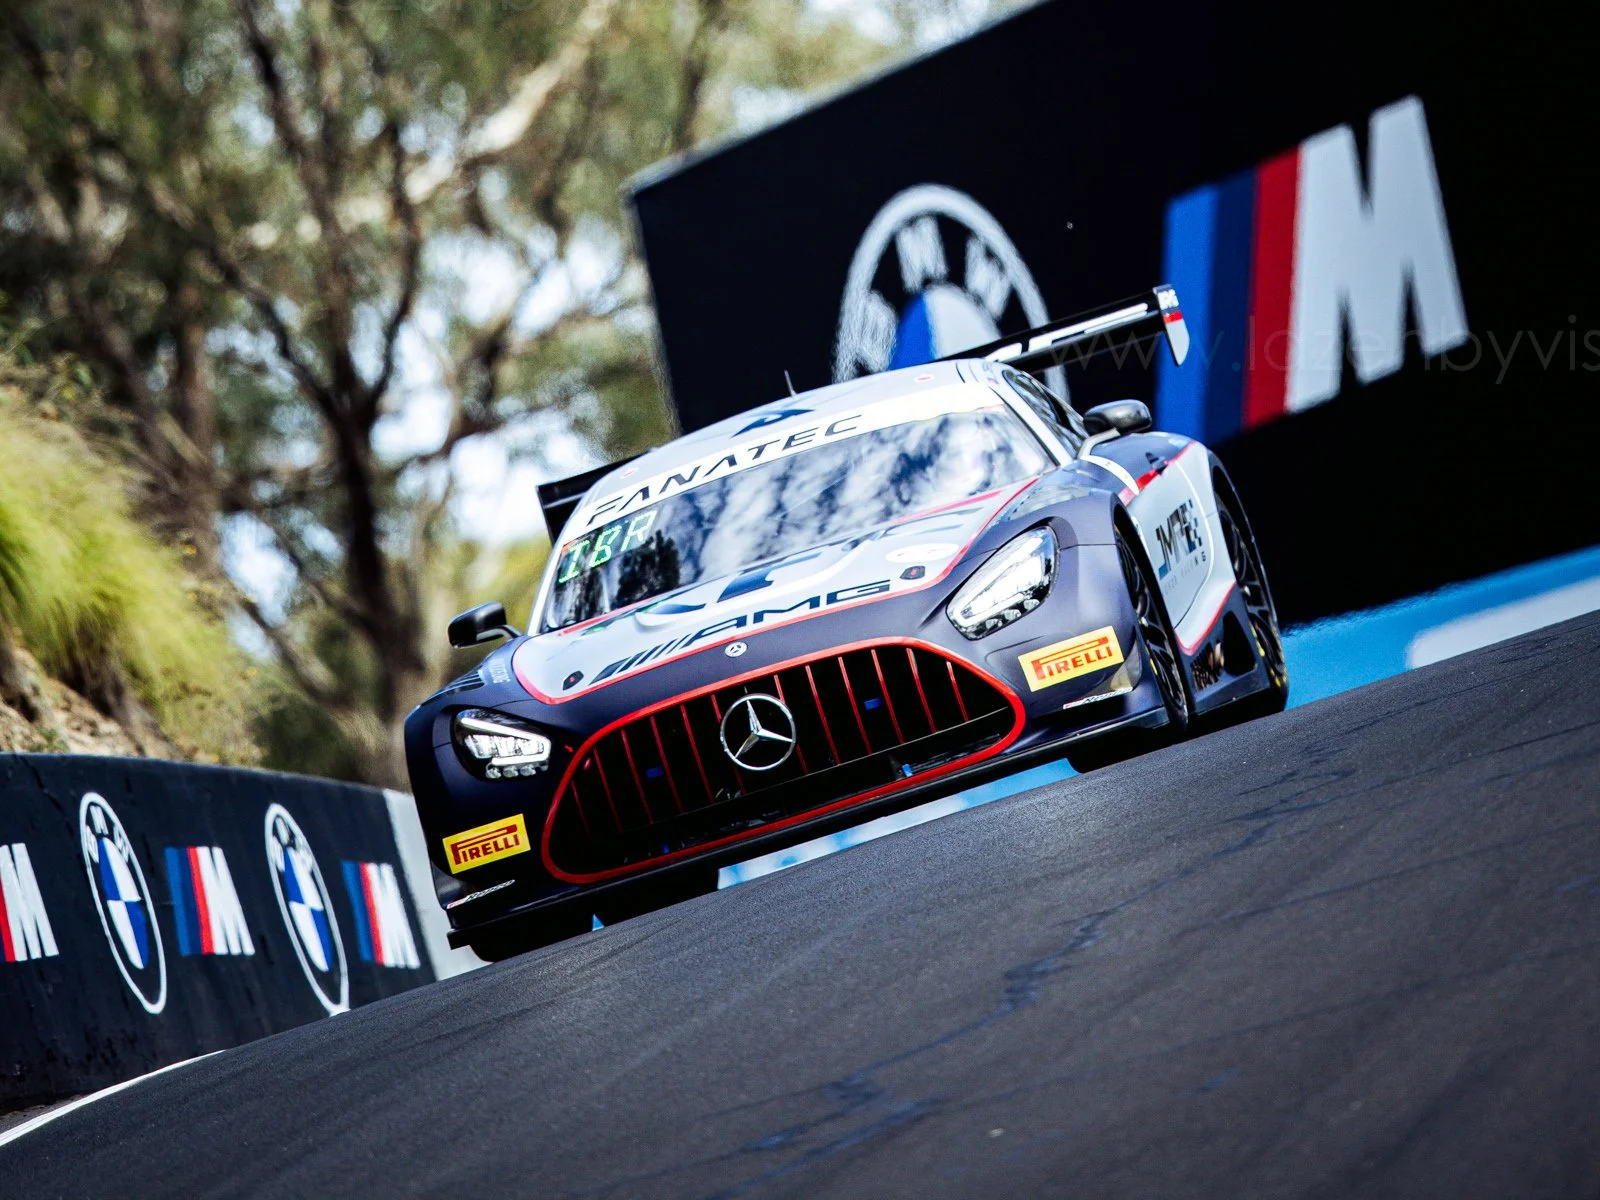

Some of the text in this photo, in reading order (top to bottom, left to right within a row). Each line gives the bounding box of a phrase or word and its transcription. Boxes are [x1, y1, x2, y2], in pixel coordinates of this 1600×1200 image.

[585, 414, 862, 527] FANATEC
[683, 579, 891, 649] AMG
[1031, 636, 1114, 681] PIRELLI
[450, 823, 521, 866] PIRELLI
